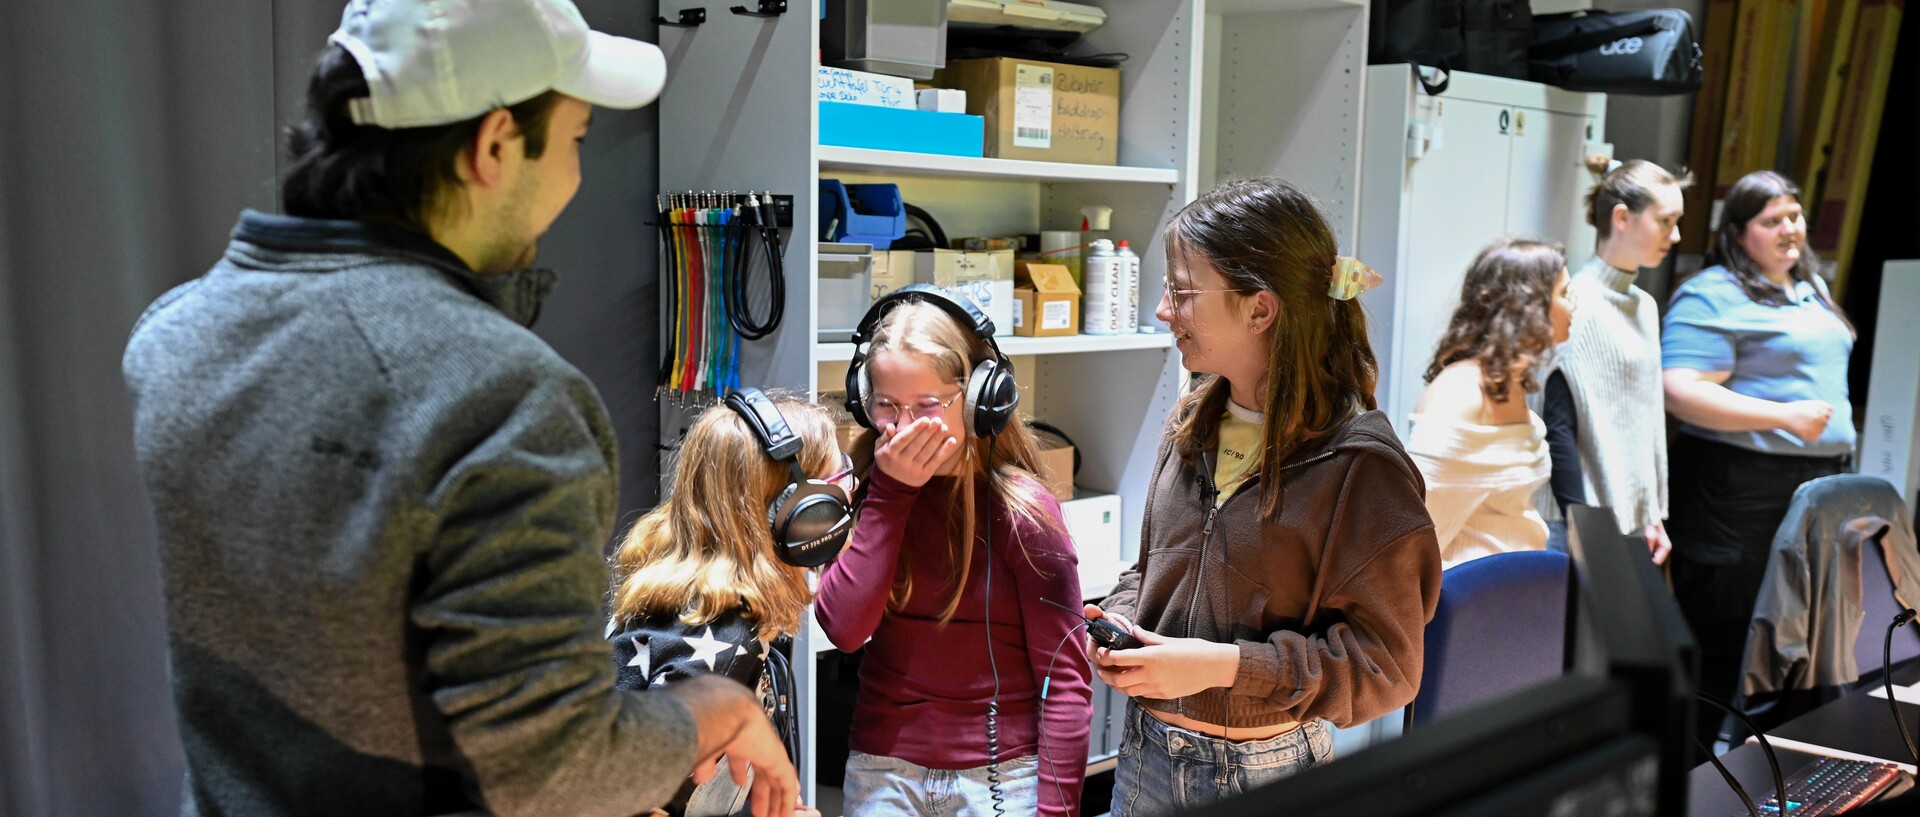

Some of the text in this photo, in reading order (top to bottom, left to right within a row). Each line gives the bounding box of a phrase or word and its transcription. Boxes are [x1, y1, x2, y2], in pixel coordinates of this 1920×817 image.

[1111, 262, 1119, 298] CLEAN
[810, 539, 821, 548] 770
[821, 534, 833, 543] PRO
